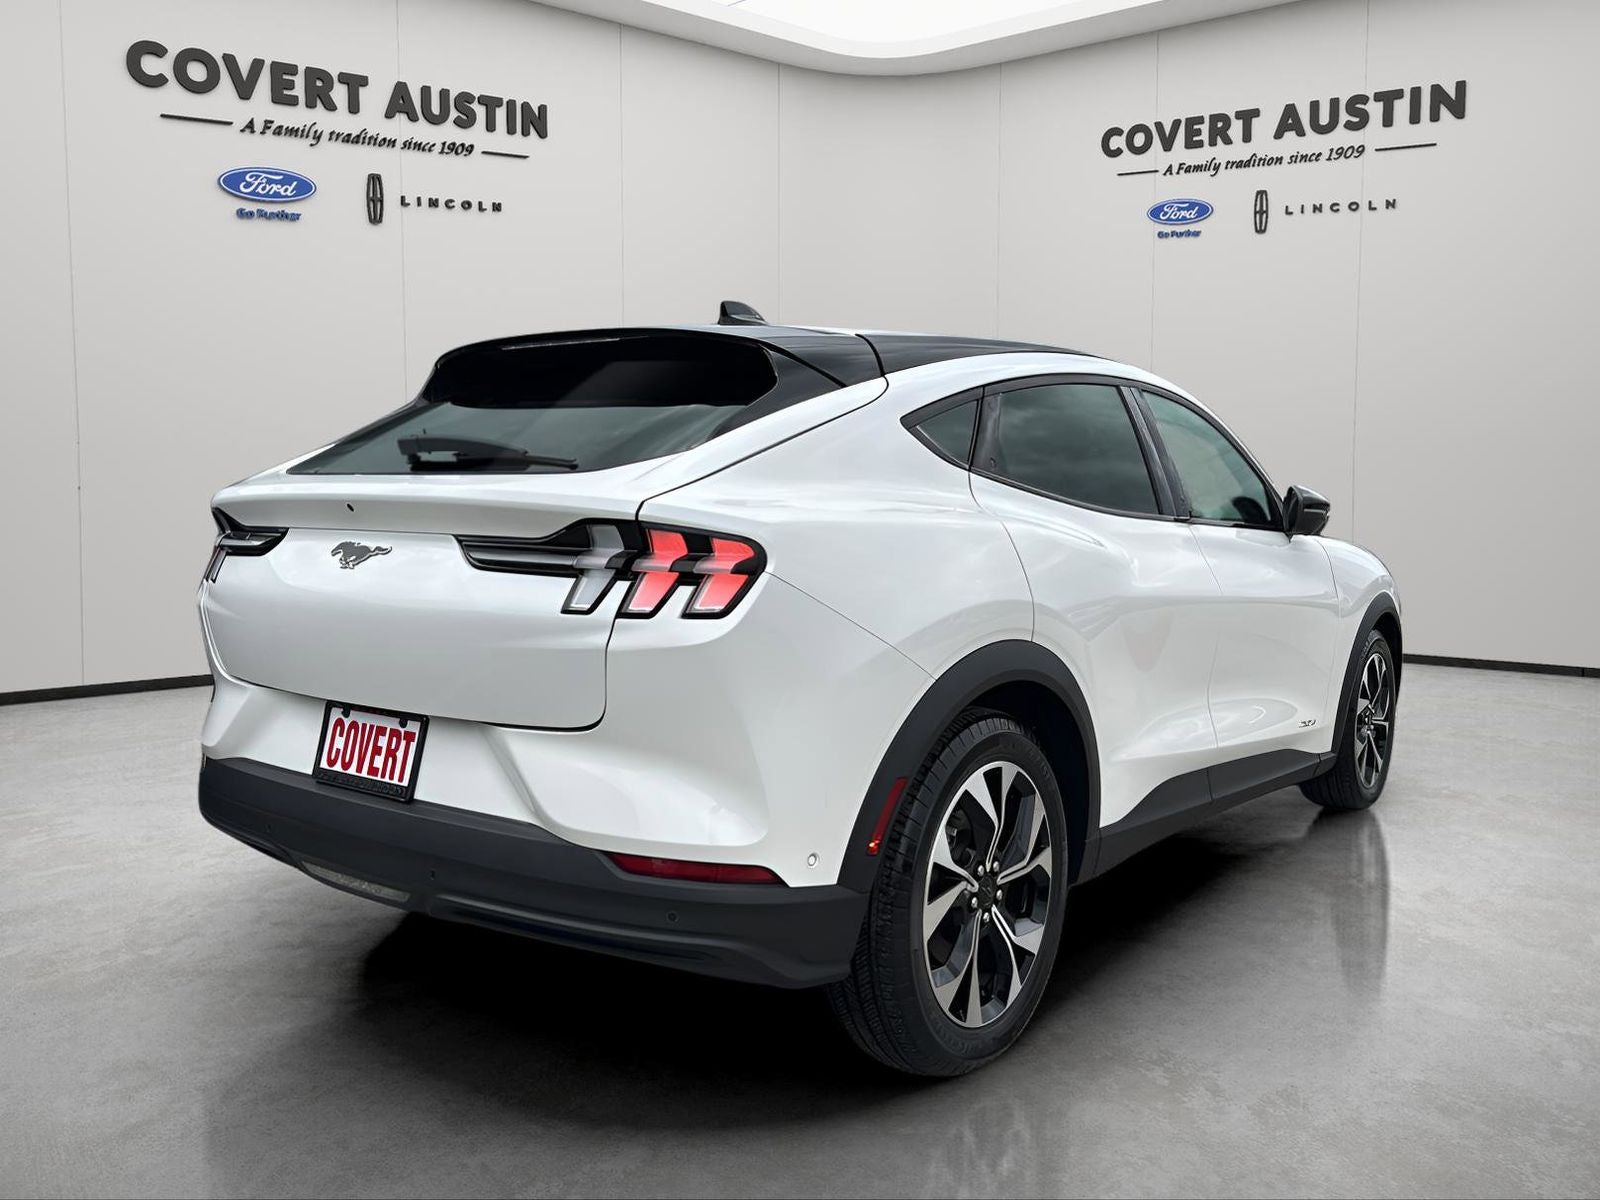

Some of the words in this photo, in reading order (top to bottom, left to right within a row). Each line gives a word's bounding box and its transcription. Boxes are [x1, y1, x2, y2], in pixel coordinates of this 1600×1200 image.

[126, 39, 369, 114] COVERT
[384, 80, 548, 140] AUSTIN
[1100, 107, 1261, 159] COVERT
[1272, 79, 1467, 141] AUSTIN
[239, 117, 256, 134] A
[260, 119, 324, 147] Family
[328, 128, 397, 148] tradition
[400, 136, 436, 154] since
[438, 140, 475, 157] 1909
[1163, 163, 1174, 176] A
[1175, 156, 1221, 177] Family
[1224, 152, 1284, 171] tradition
[1287, 150, 1323, 165] since
[1325, 144, 1366, 162] 1909
[239, 171, 298, 197] Ford
[400, 195, 503, 213] LINCOLN
[1159, 202, 1199, 220] Ford
[1284, 198, 1397, 216] LINCOLN
[326, 717, 417, 784] COVERT
